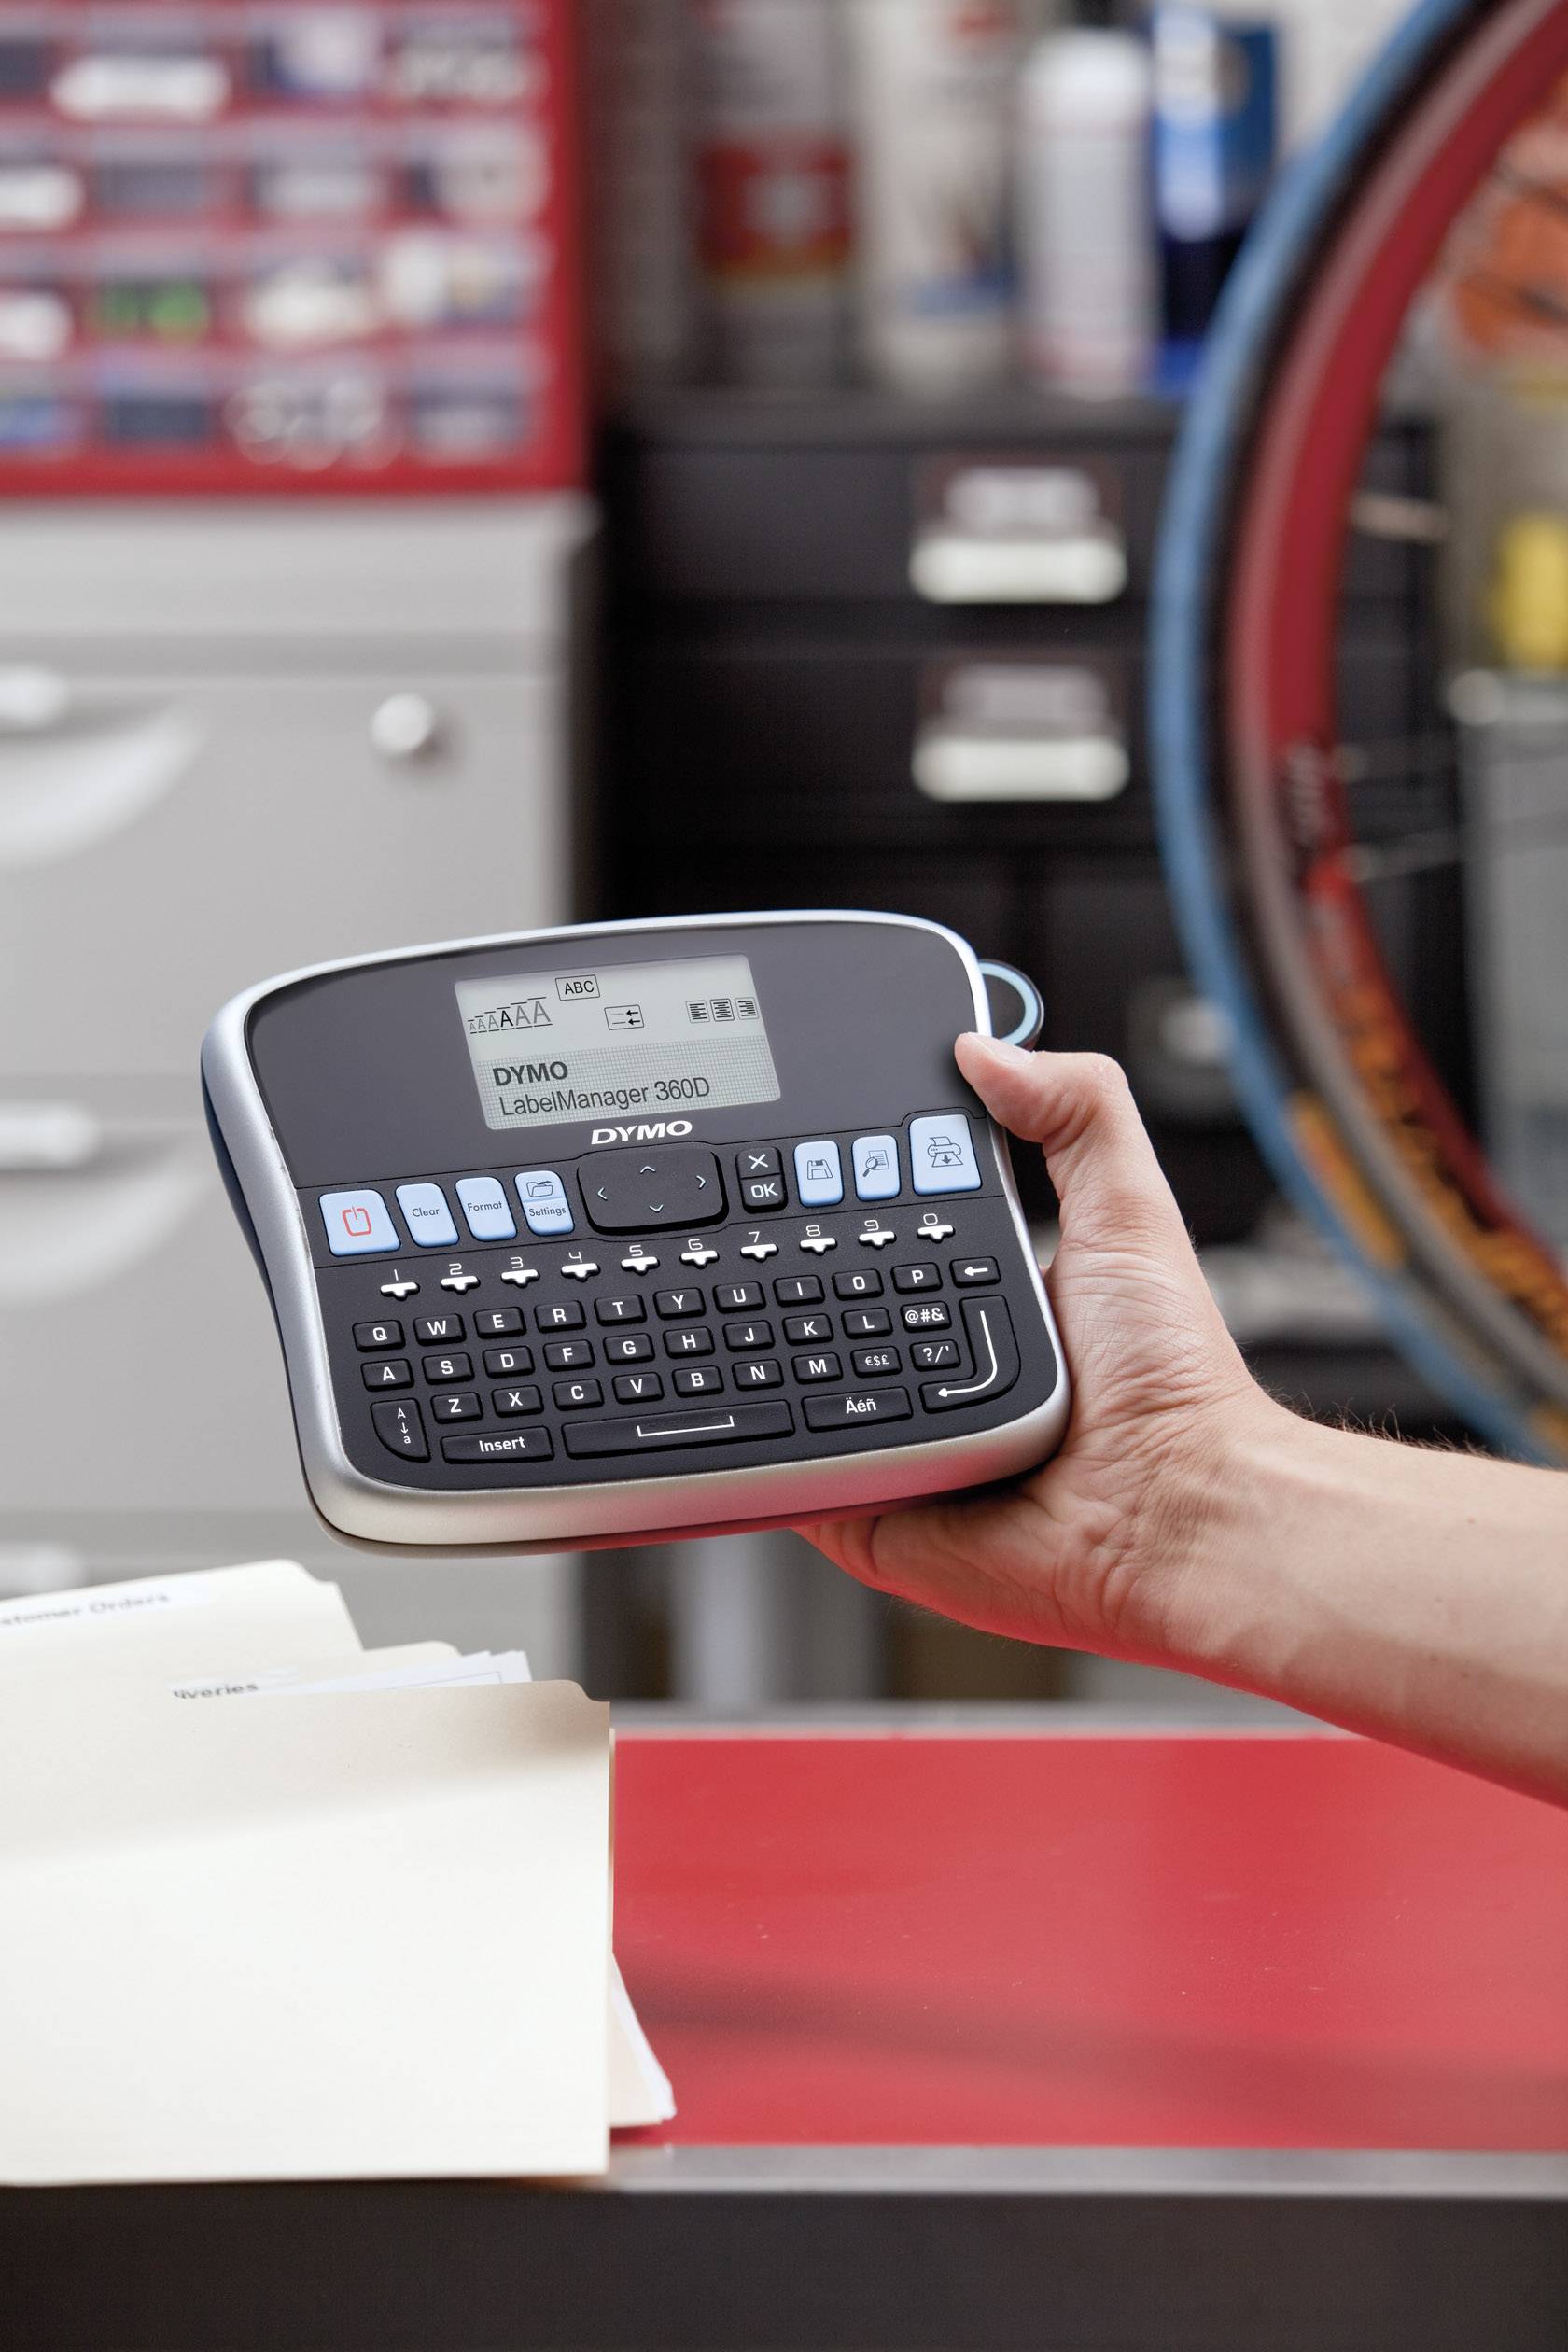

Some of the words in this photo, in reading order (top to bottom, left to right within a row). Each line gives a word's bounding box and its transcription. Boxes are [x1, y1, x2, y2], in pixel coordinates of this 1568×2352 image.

[564, 981, 595, 995] ABC
[493, 1061, 568, 1087] DYMO
[498, 1085, 649, 1116] LabelManager
[654, 1076, 710, 1100] 360D
[591, 1120, 693, 1145] DYMO
[750, 1183, 778, 1199] OK
[412, 1207, 440, 1218] Clear
[467, 1200, 503, 1212] Format
[528, 1206, 567, 1218] Settings
[448, 1263, 463, 1276] 2
[510, 1256, 525, 1269] 3
[568, 1251, 583, 1264] 4
[629, 1245, 645, 1257] 5
[688, 1238, 703, 1251] 6
[748, 1231, 761, 1243] 7
[805, 1225, 821, 1237] 8
[864, 1219, 880, 1231] 9
[922, 1213, 938, 1225] 0
[372, 1326, 388, 1341] Q
[427, 1320, 446, 1336] W
[492, 1314, 505, 1329] E
[552, 1308, 567, 1323] R
[612, 1301, 623, 1316] T
[671, 1295, 684, 1309] Y
[732, 1288, 747, 1303] U
[796, 1281, 804, 1296] I
[852, 1276, 866, 1291] O
[911, 1269, 924, 1284] P
[383, 1366, 396, 1381] A
[440, 1360, 454, 1375] S
[500, 1353, 515, 1368] D
[562, 1347, 573, 1362] F
[623, 1340, 637, 1355] G
[681, 1334, 696, 1349] H
[744, 1327, 755, 1342] J
[803, 1321, 818, 1336] K
[862, 1315, 875, 1330] L
[904, 1307, 945, 1323] @#&
[448, 1398, 462, 1413] Z
[508, 1392, 524, 1407] X
[570, 1385, 584, 1400] C
[629, 1379, 643, 1393] V
[690, 1372, 705, 1387] B
[749, 1365, 766, 1380] N
[808, 1358, 827, 1375] M
[864, 1354, 889, 1367] €$£
[397, 1407, 406, 1420] A
[846, 1396, 877, 1414] Äéñ
[402, 1435, 412, 1444] a
[479, 1436, 526, 1452] Insert
